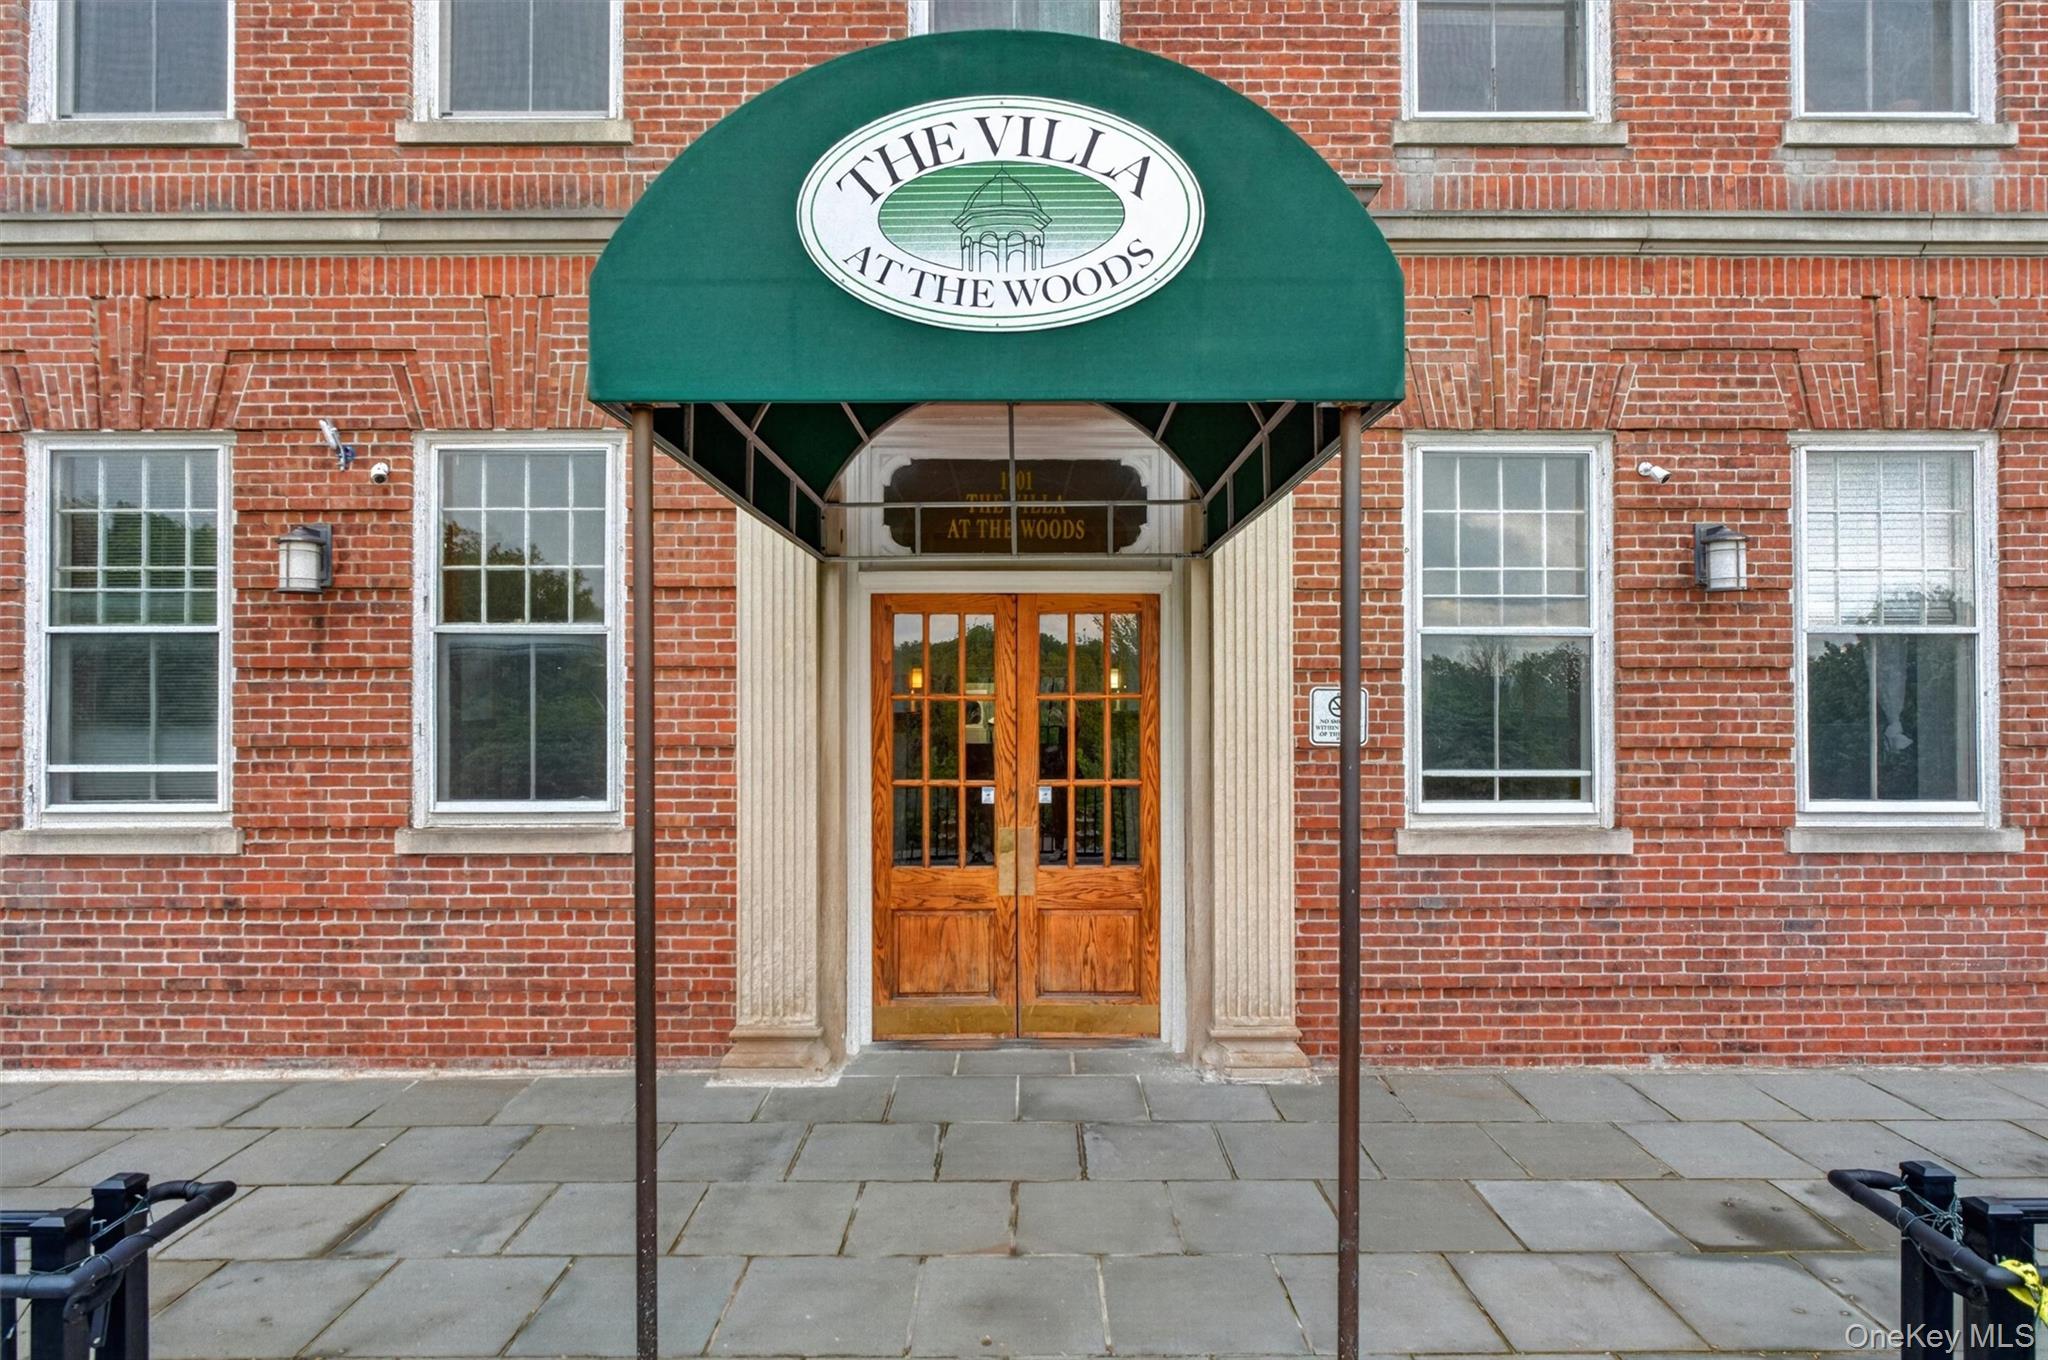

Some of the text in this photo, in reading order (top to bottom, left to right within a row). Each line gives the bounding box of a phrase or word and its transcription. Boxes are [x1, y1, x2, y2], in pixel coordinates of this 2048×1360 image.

[836, 115, 1153, 205] THE VILLA
[842, 237, 1154, 308] AT THE WOODS
[1000, 470, 1033, 490] 101
[966, 493, 1066, 514] THE ILLA
[947, 519, 971, 539] AT
[1020, 519, 1085, 540] WOODS
